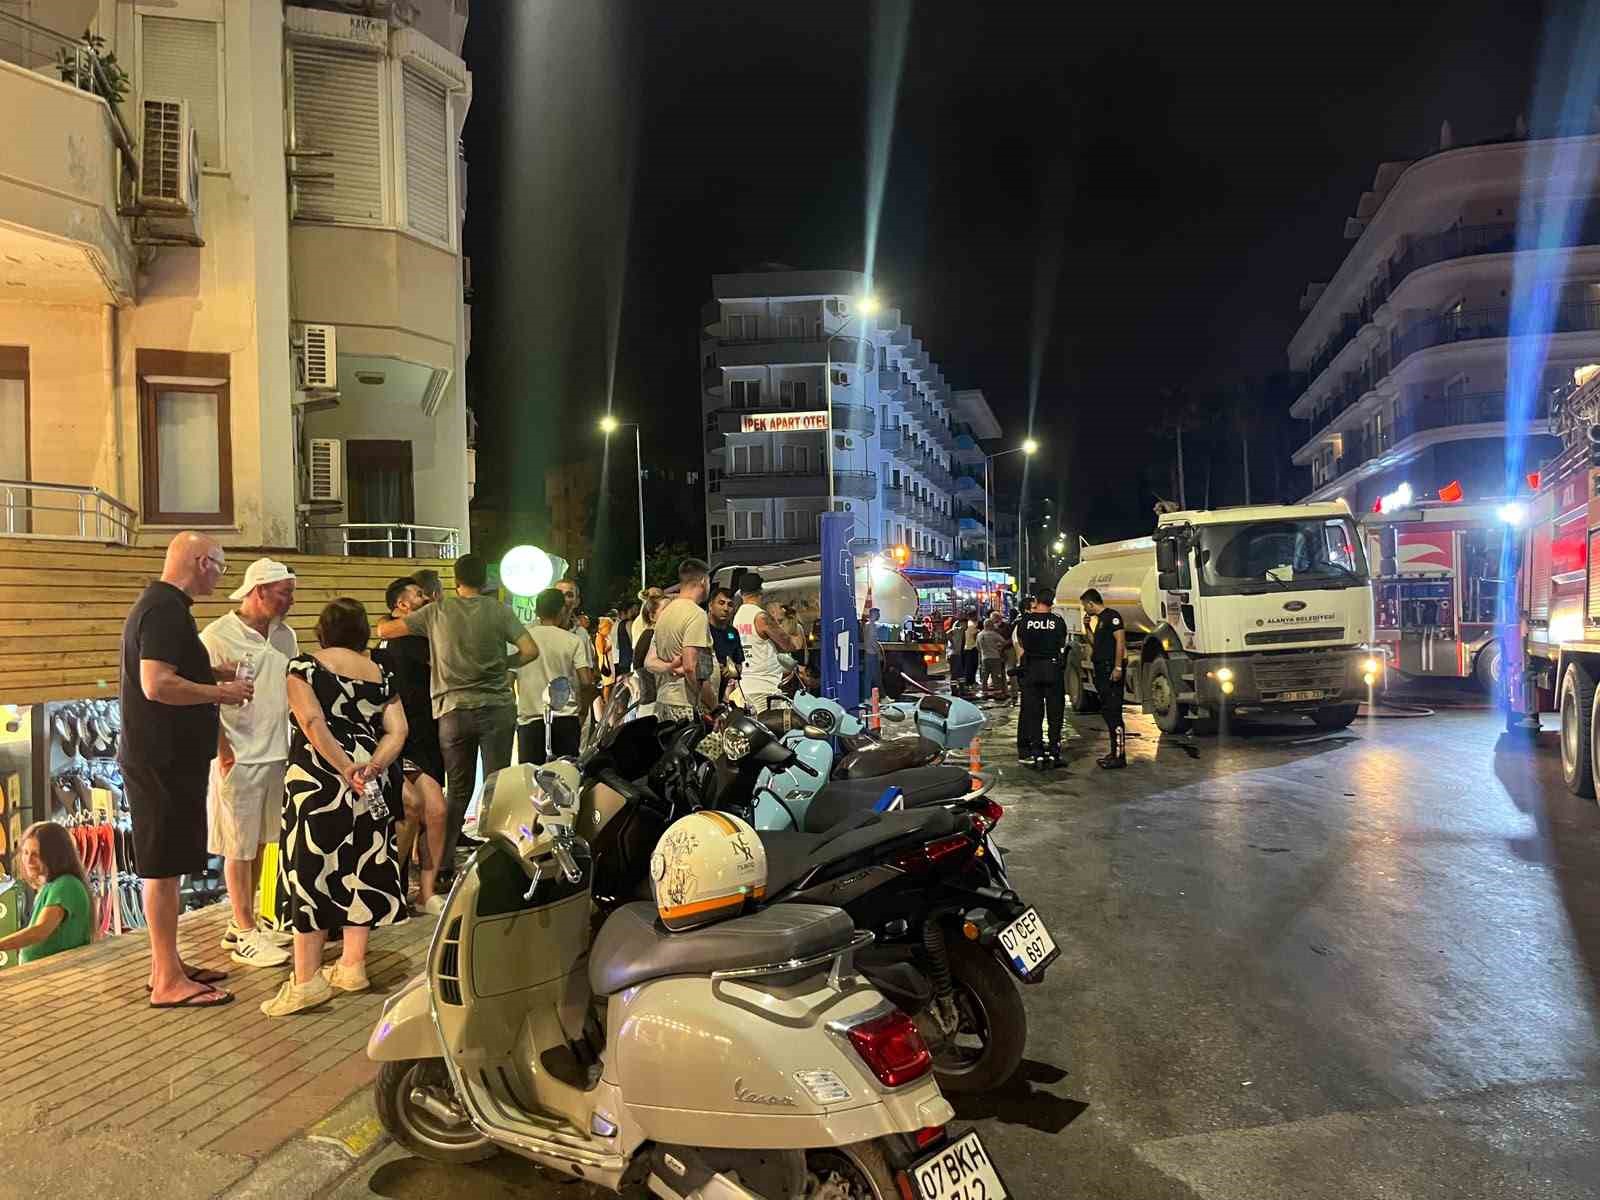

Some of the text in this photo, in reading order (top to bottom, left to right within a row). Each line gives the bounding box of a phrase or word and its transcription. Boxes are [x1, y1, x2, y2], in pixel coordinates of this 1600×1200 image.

[770, 416, 801, 430] APART
[803, 415, 828, 428] OTEL
[1026, 619, 1056, 630] POLİS
[1002, 911, 1037, 951] 07 CEP
[1025, 936, 1046, 963] 697
[921, 1137, 987, 1200] 07 BKH
